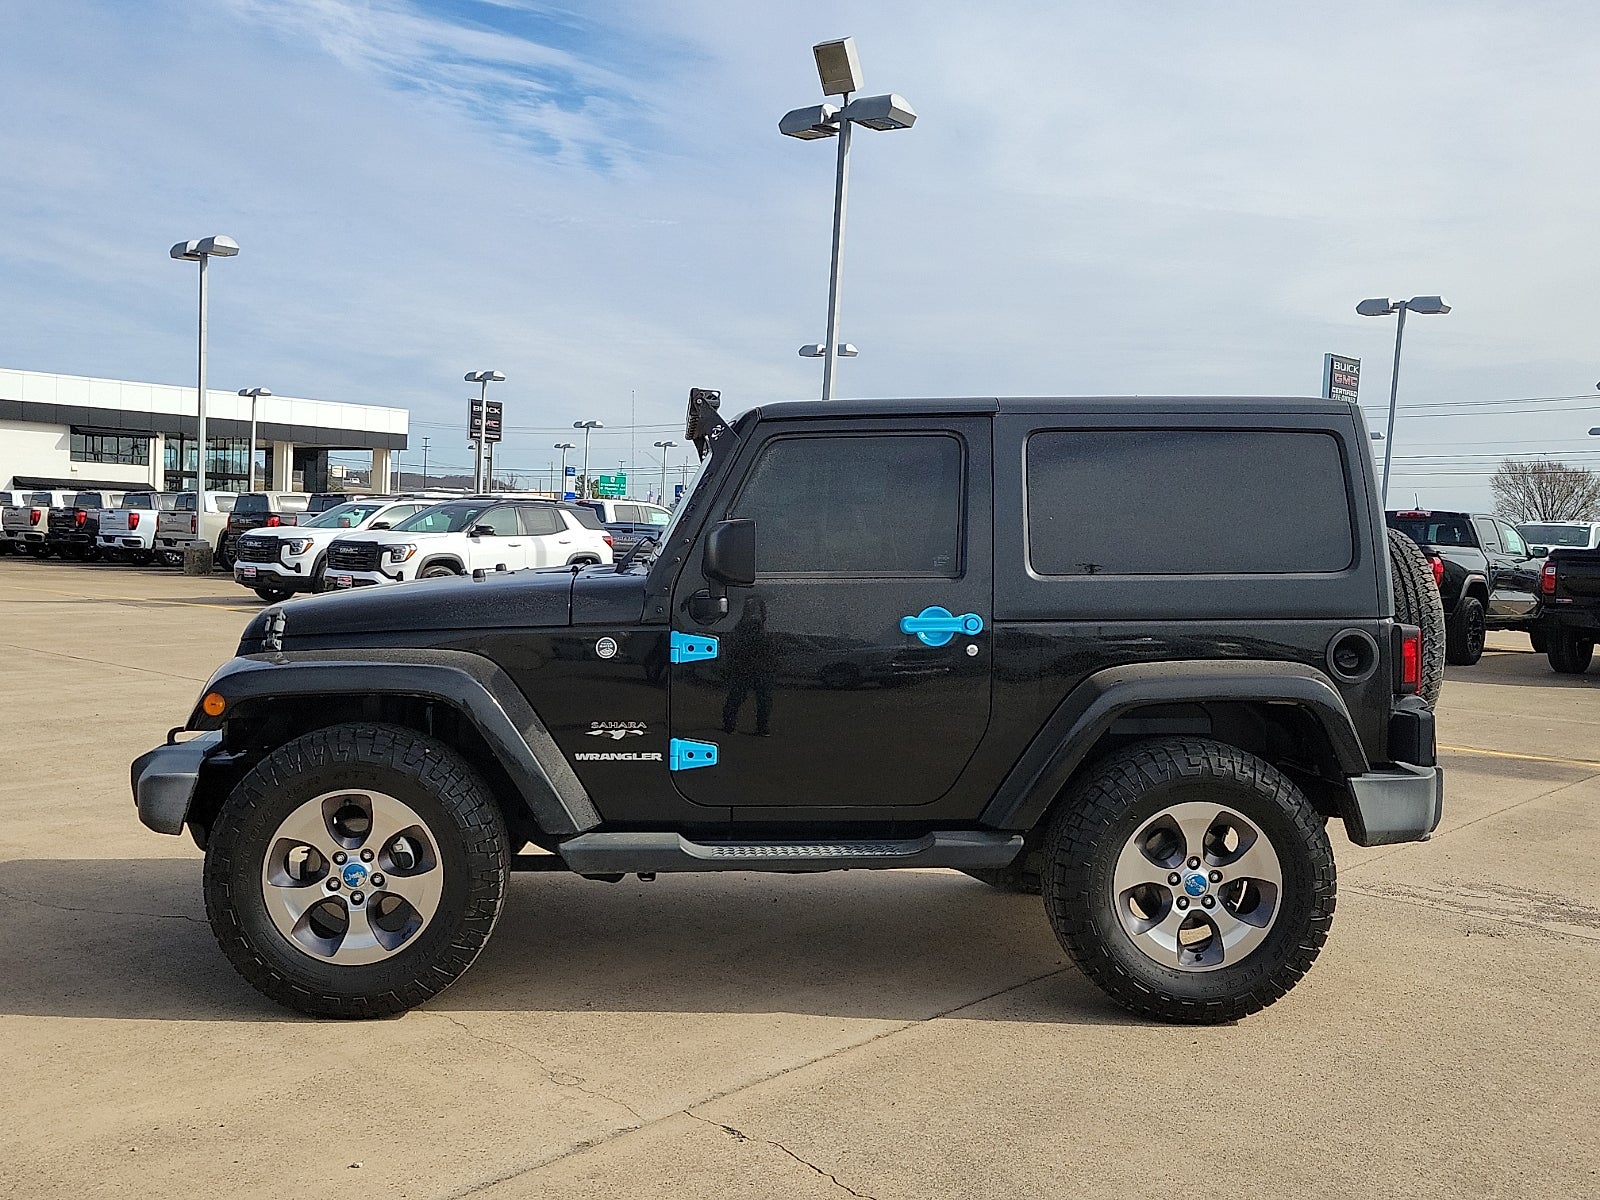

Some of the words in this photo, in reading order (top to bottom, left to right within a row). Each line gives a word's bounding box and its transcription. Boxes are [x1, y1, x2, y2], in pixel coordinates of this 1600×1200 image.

[1334, 361, 1359, 374] BUICK
[1334, 373, 1358, 386] GMC
[591, 721, 647, 729] SAHARA
[574, 752, 663, 761] WRANGLER
